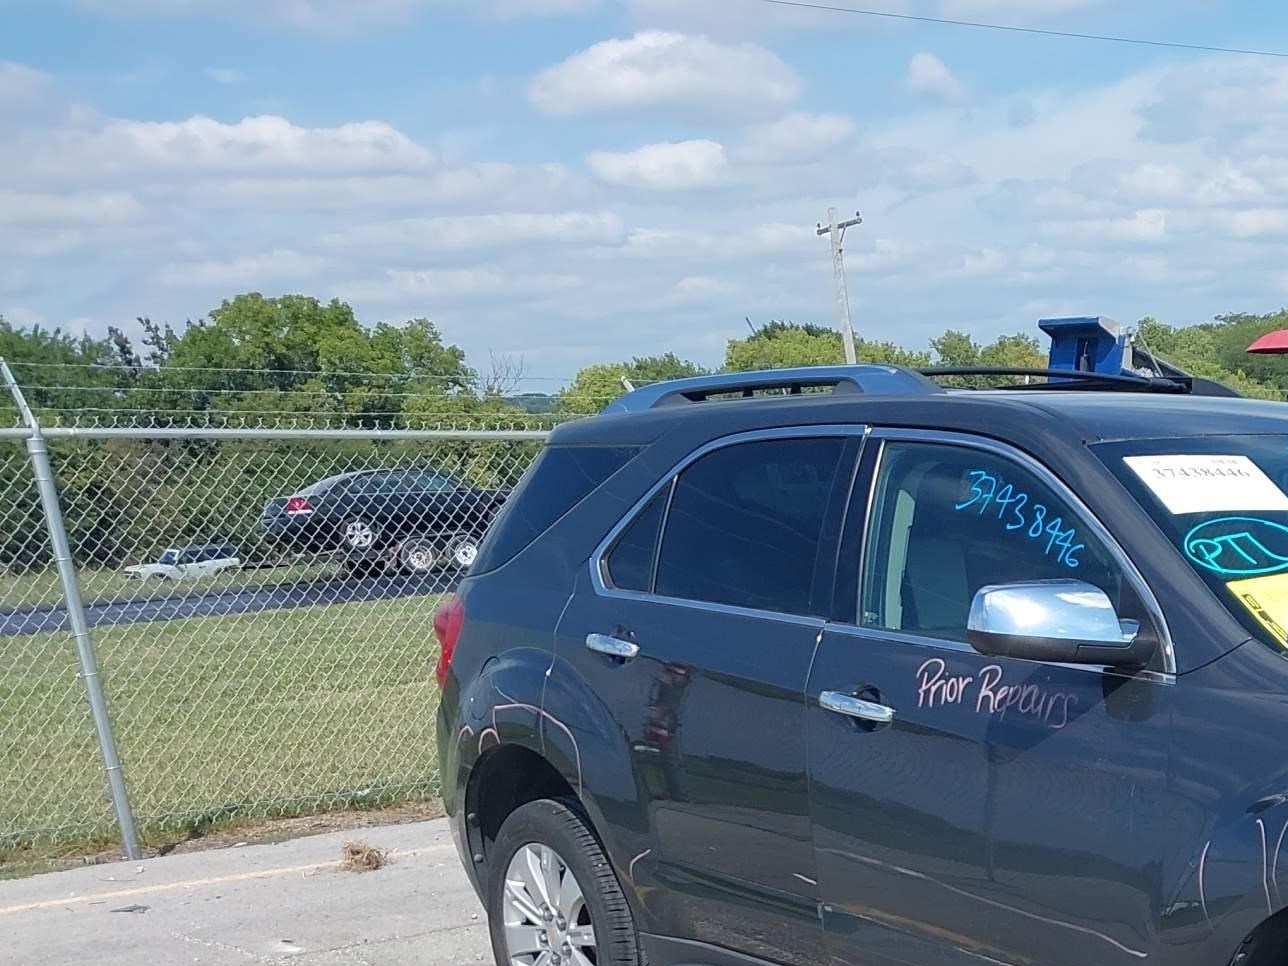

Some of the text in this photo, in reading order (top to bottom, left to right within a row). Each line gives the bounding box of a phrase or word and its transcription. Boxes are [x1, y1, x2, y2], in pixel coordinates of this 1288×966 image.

[955, 470, 1085, 568] 37438446
[916, 658, 1080, 728] Prior Repairs
